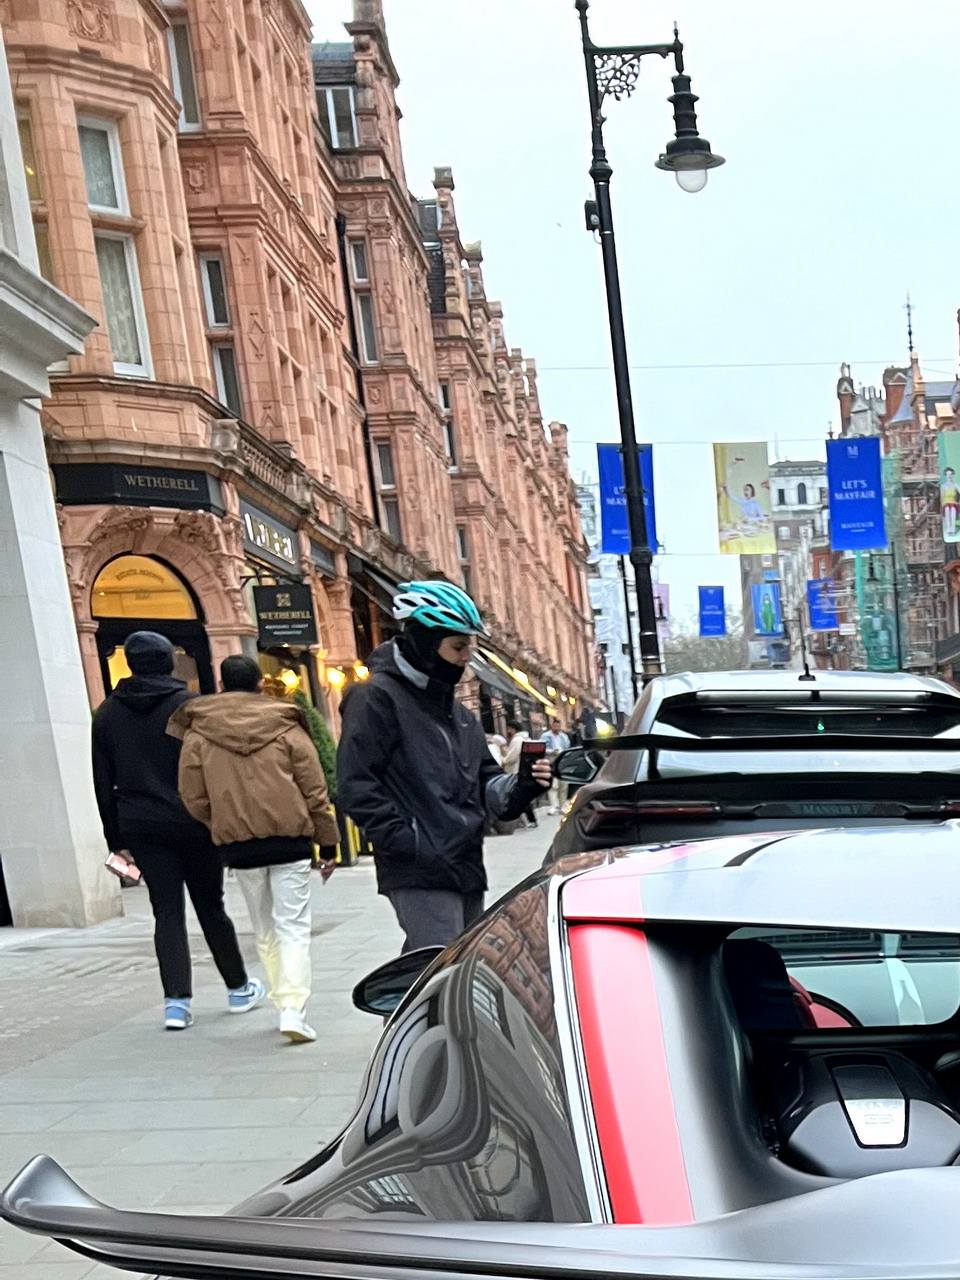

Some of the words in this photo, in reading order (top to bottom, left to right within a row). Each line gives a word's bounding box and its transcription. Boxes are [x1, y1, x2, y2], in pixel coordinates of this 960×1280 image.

[124, 474, 199, 491] WETHERELL
[841, 480, 868, 490] LET'S
[834, 490, 877, 501] MAYFAIR
